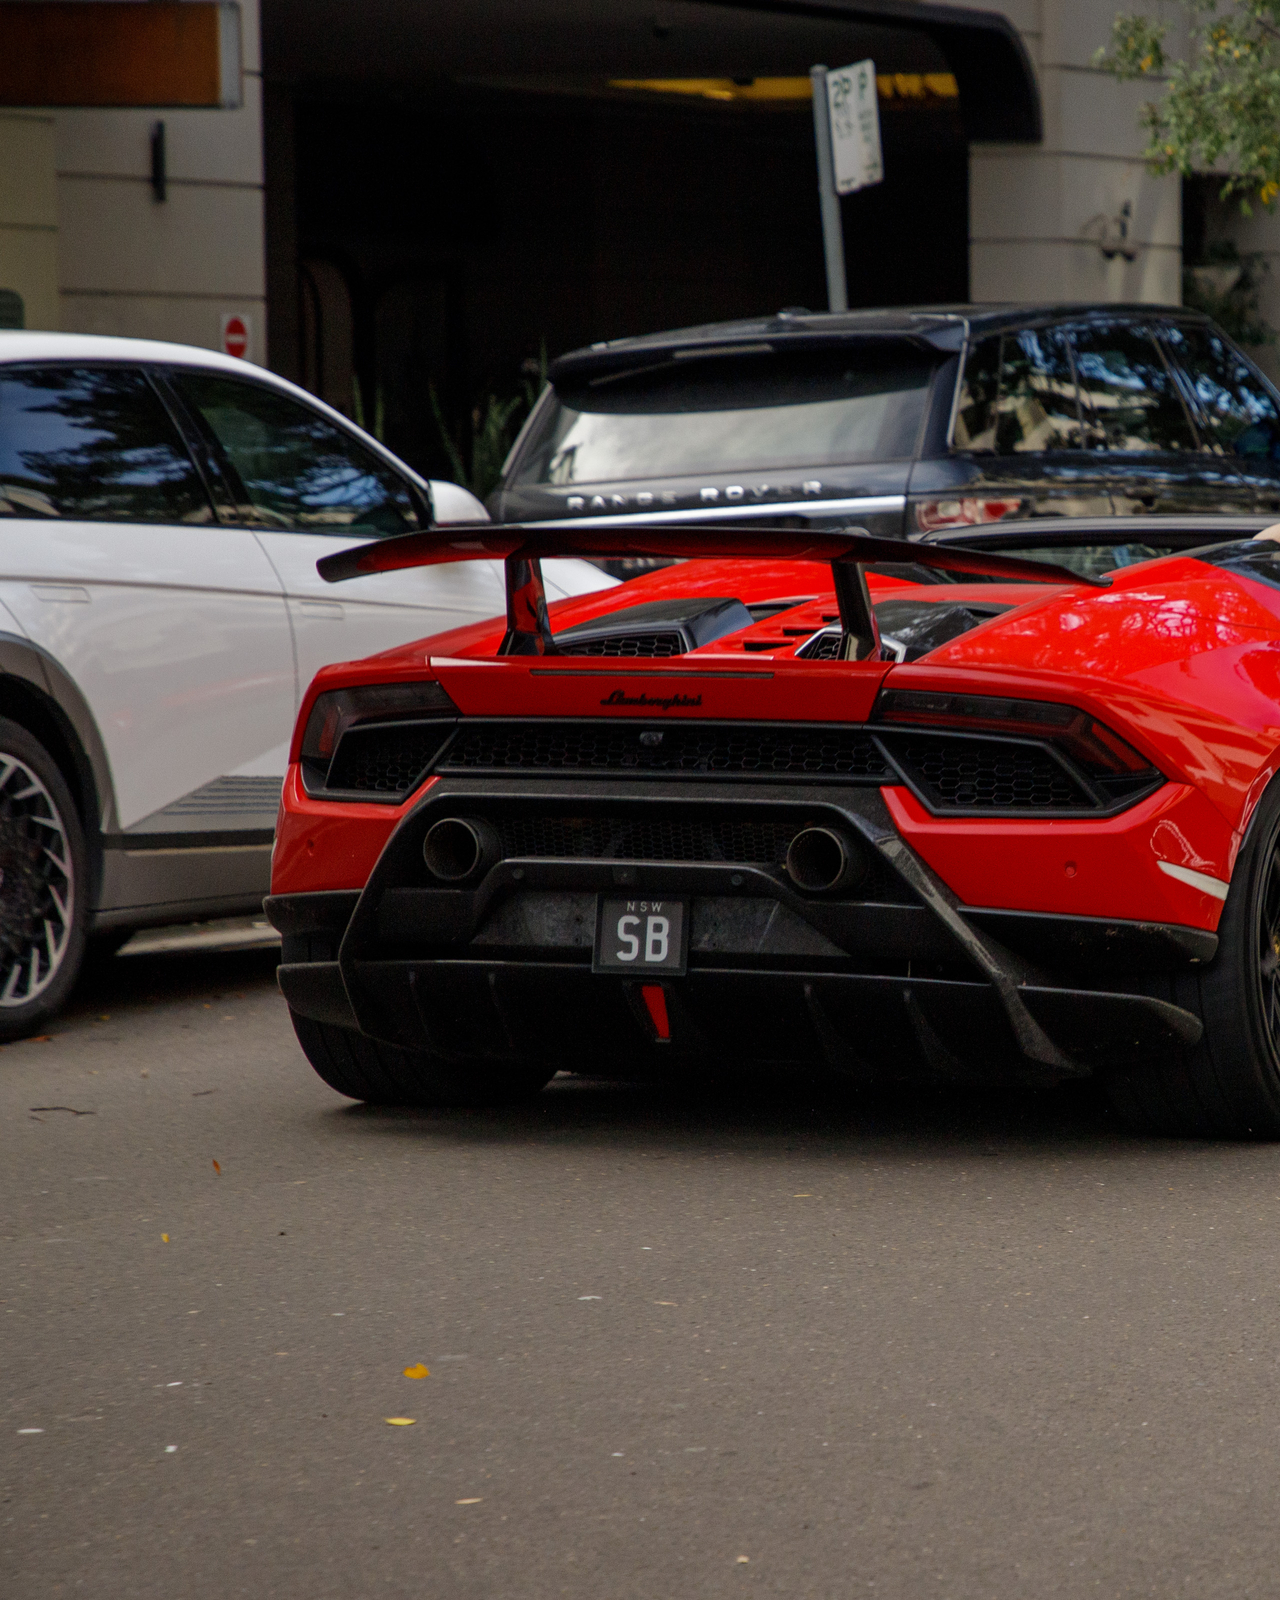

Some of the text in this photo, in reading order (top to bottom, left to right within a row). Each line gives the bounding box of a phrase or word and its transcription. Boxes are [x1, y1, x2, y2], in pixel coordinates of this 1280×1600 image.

[567, 480, 822, 510] RANGE ROVER
[600, 690, 702, 710] Lamborghini
[616, 915, 669, 962] SB
